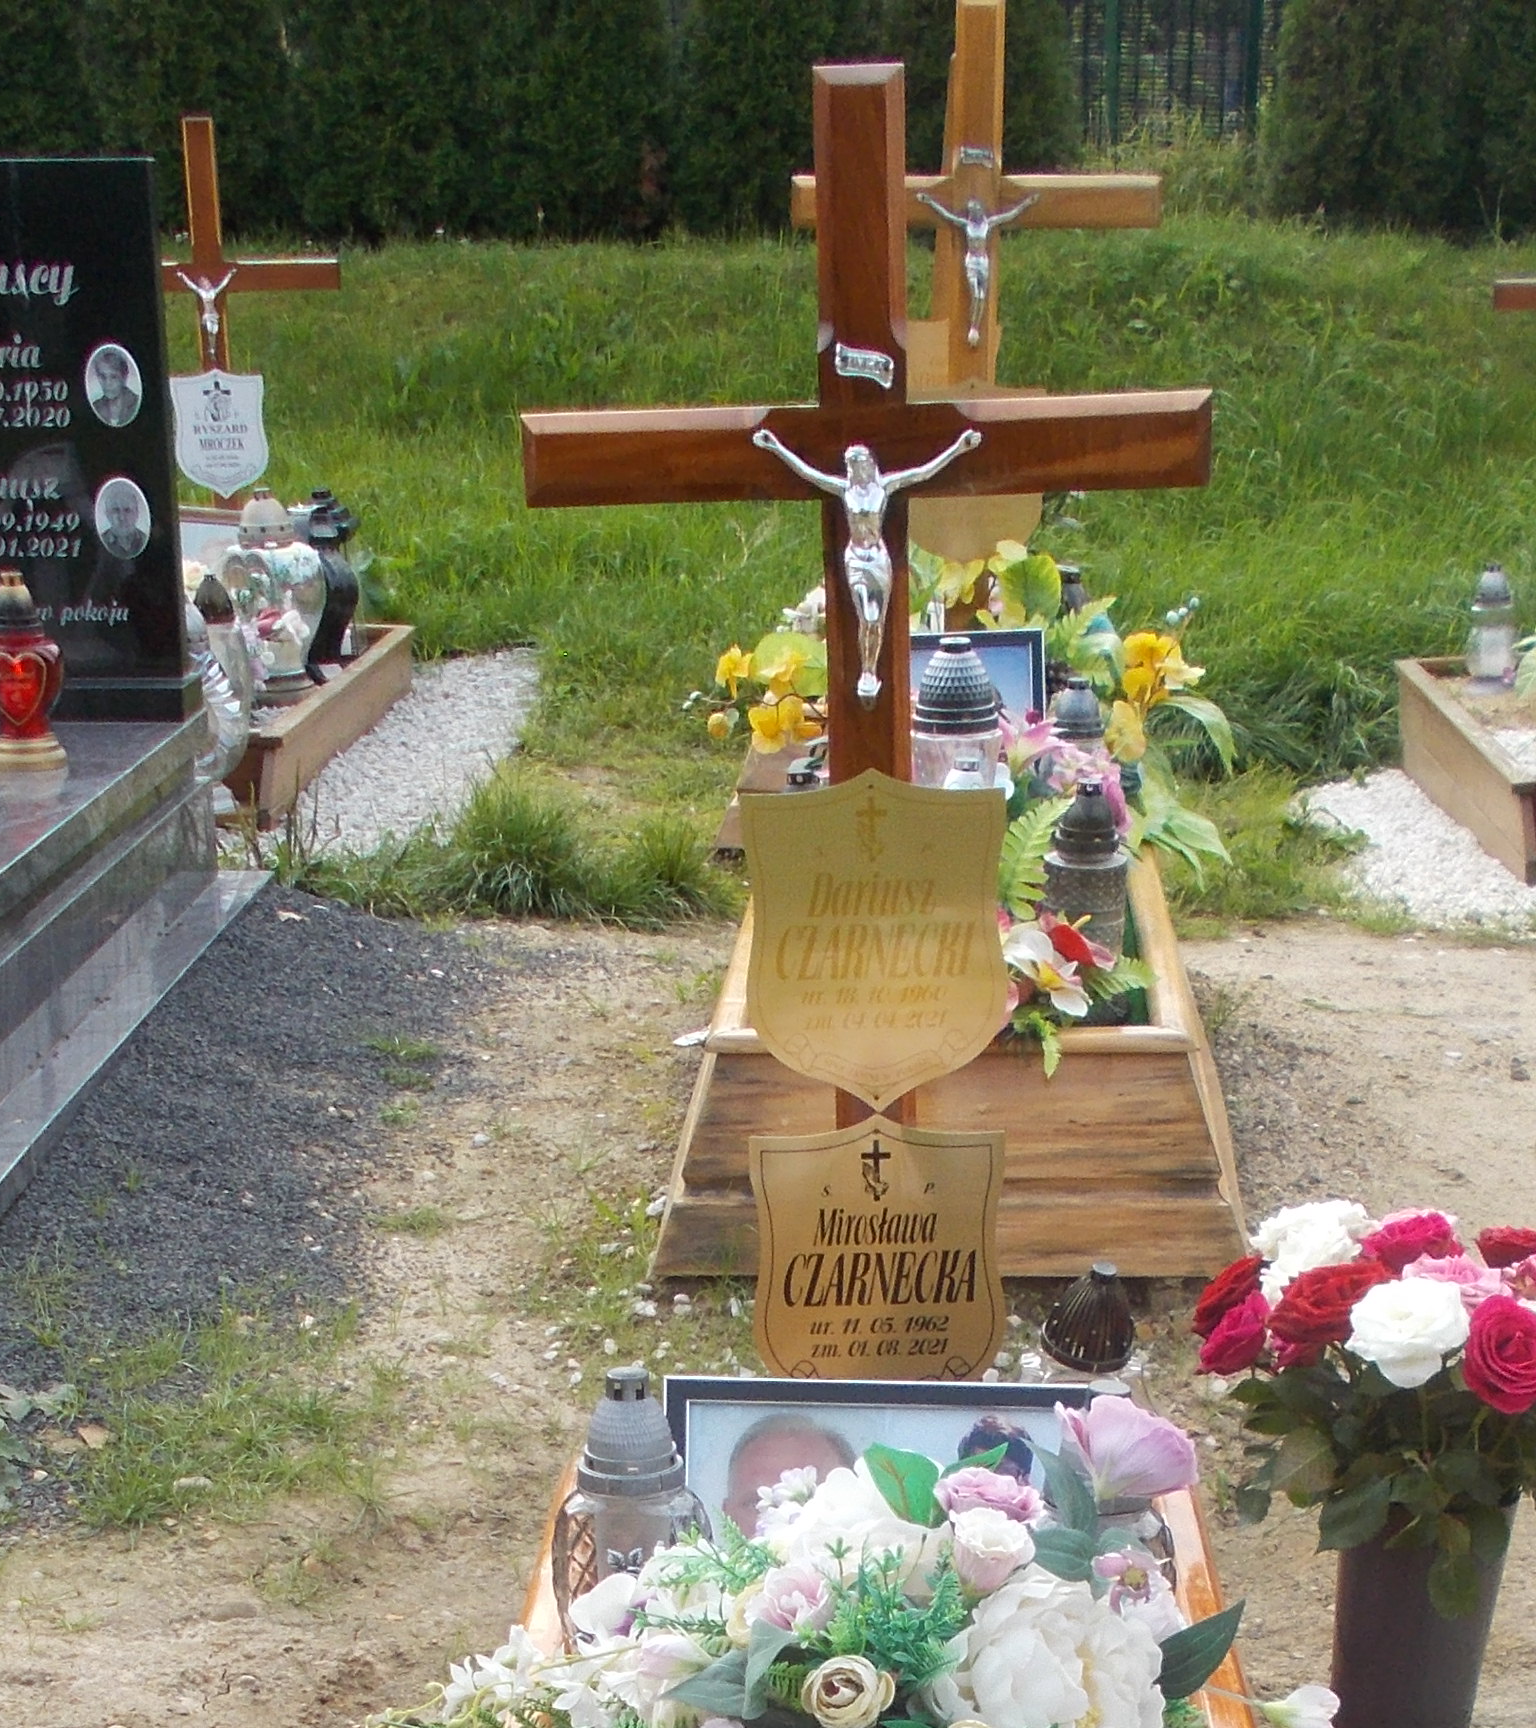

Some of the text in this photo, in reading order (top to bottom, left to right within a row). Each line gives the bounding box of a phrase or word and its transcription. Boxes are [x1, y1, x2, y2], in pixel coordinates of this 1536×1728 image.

[193, 424, 248, 435] RYSZARD
[60, 600, 129, 626] pokoju
[807, 871, 937, 917] Dariusz
[775, 921, 976, 981] CZARNECKI
[813, 1207, 938, 1247] Mirosława
[783, 1249, 977, 1308] CZARNECKA
[809, 1320, 834, 1335] ur.
[870, 1317, 896, 1334] 05.
[905, 1315, 949, 1333] 1962
[811, 1343, 841, 1359] zm.
[848, 1341, 870, 1358] 01.
[908, 1337, 948, 1356] 2021
